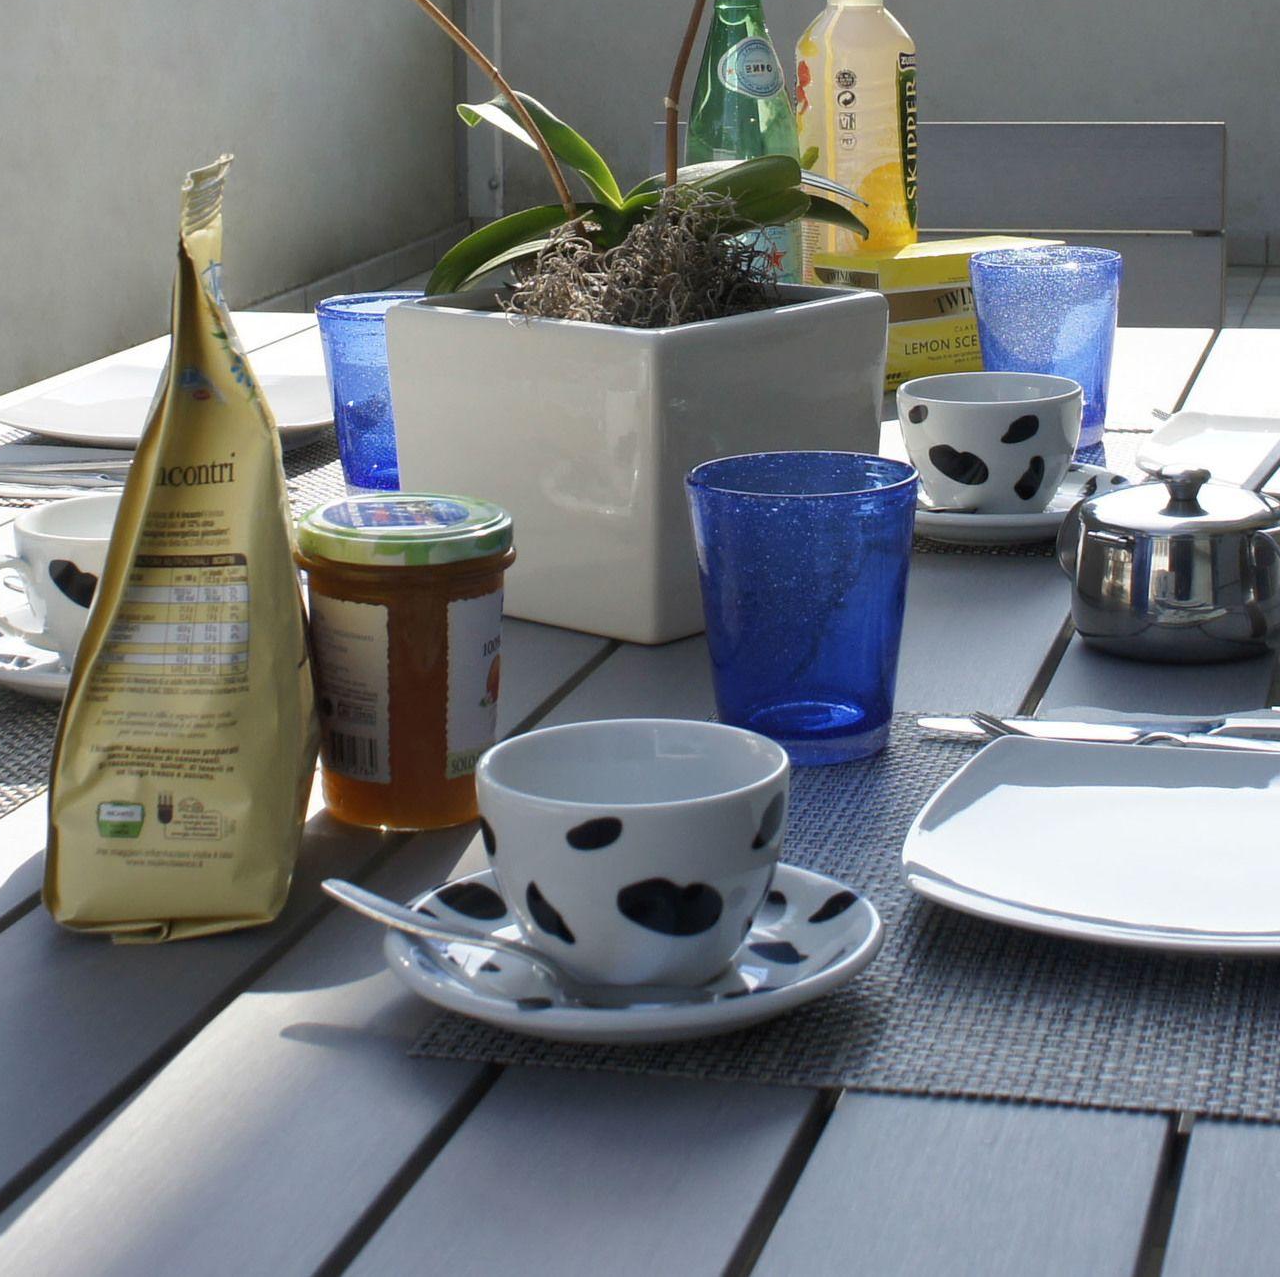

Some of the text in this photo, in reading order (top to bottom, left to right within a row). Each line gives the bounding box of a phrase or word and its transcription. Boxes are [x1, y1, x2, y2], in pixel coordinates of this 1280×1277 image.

[906, 81, 918, 200] SKIPPER
[905, 335, 978, 356] LEMON SCE
